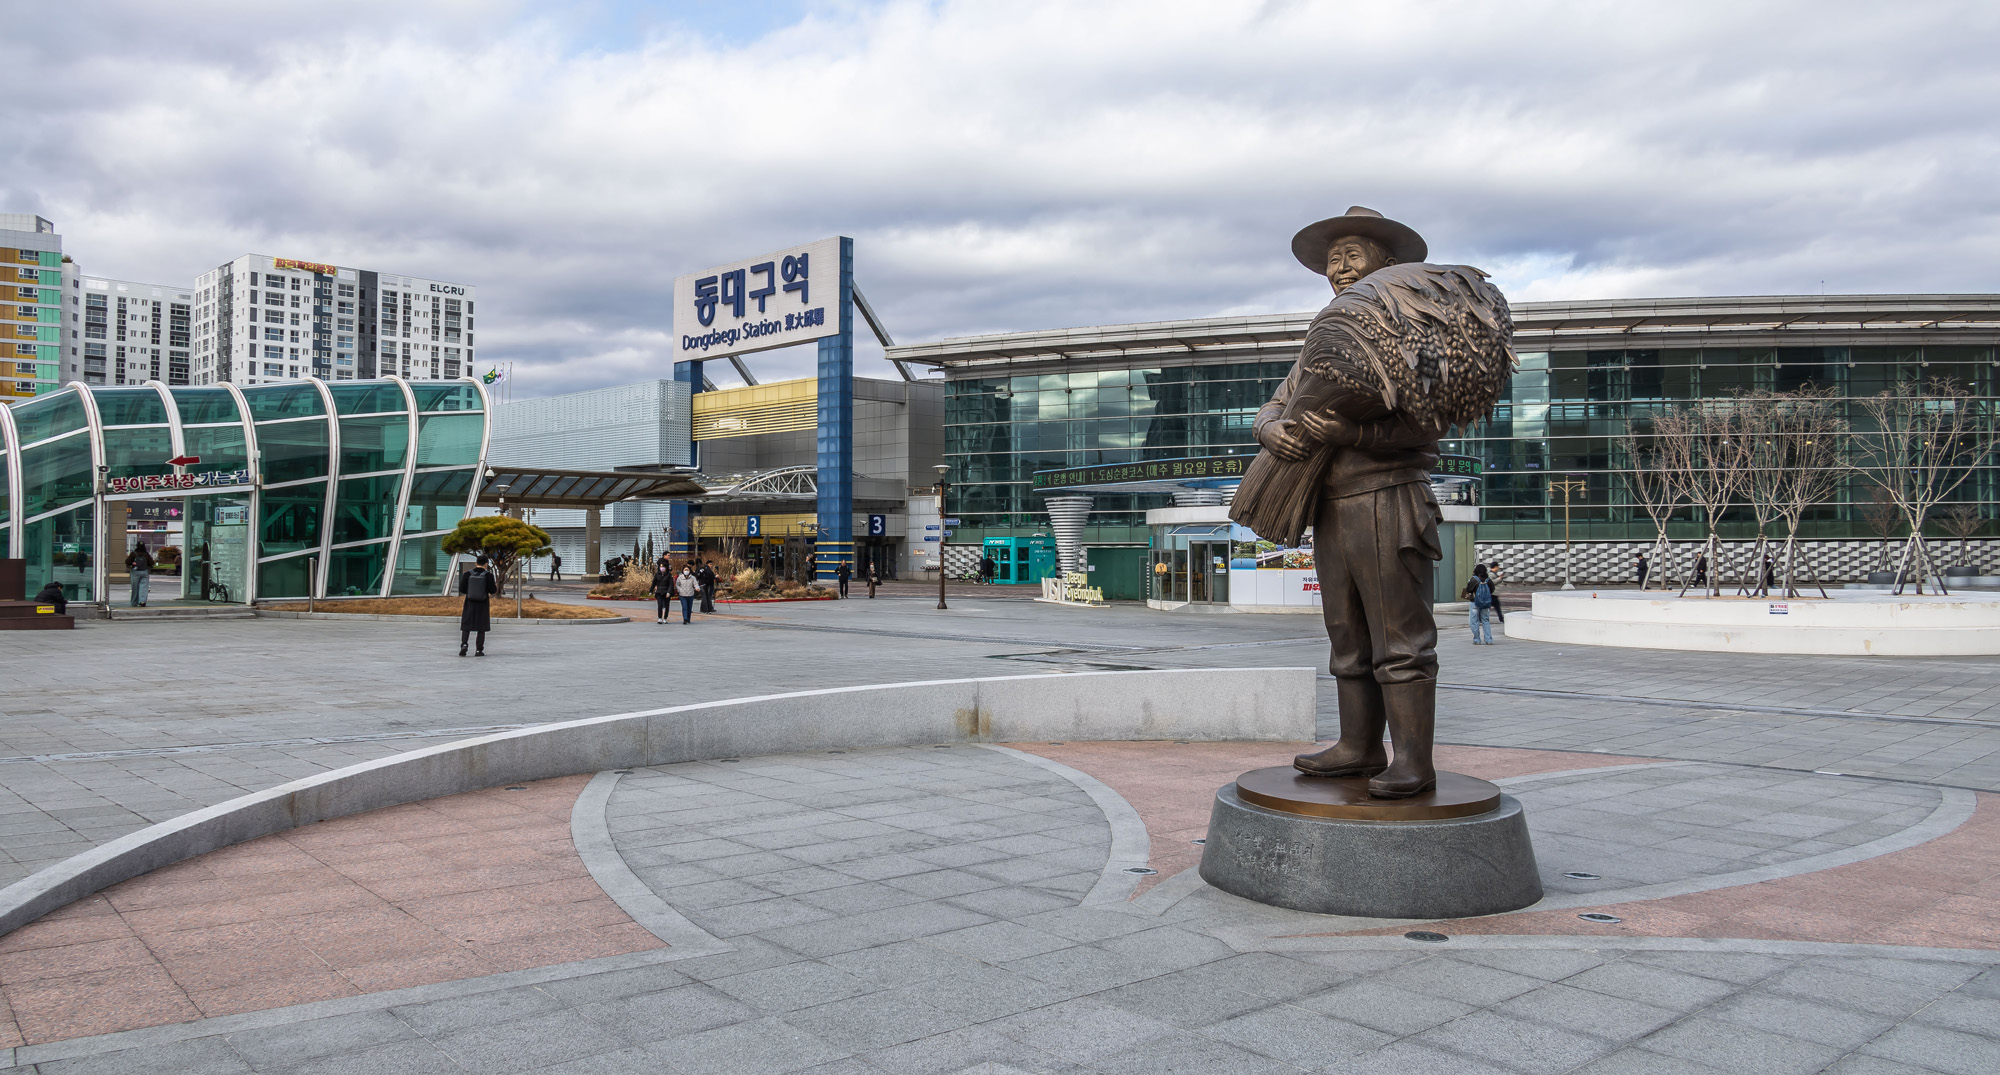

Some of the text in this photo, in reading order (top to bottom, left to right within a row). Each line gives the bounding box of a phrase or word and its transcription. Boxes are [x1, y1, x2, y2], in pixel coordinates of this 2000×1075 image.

[694, 252, 809, 327] 동대구역
[682, 327, 741, 351] Dongdaegu
[742, 318, 782, 340] Station
[1053, 472, 1067, 485] 운행
[1172, 461, 1207, 476] 월요일
[1212, 459, 1242, 474] 운휴)
[1447, 459, 1456, 473] 및
[1458, 460, 1471, 473] 문의
[112, 469, 249, 493] 맞이주차장 가는 길
[750, 517, 758, 535] 3
[872, 516, 883, 534] 3
[1041, 576, 1066, 601] VISIT
[1066, 570, 1087, 588] Daegu
[1066, 585, 1104, 604] Gyeongbuk
